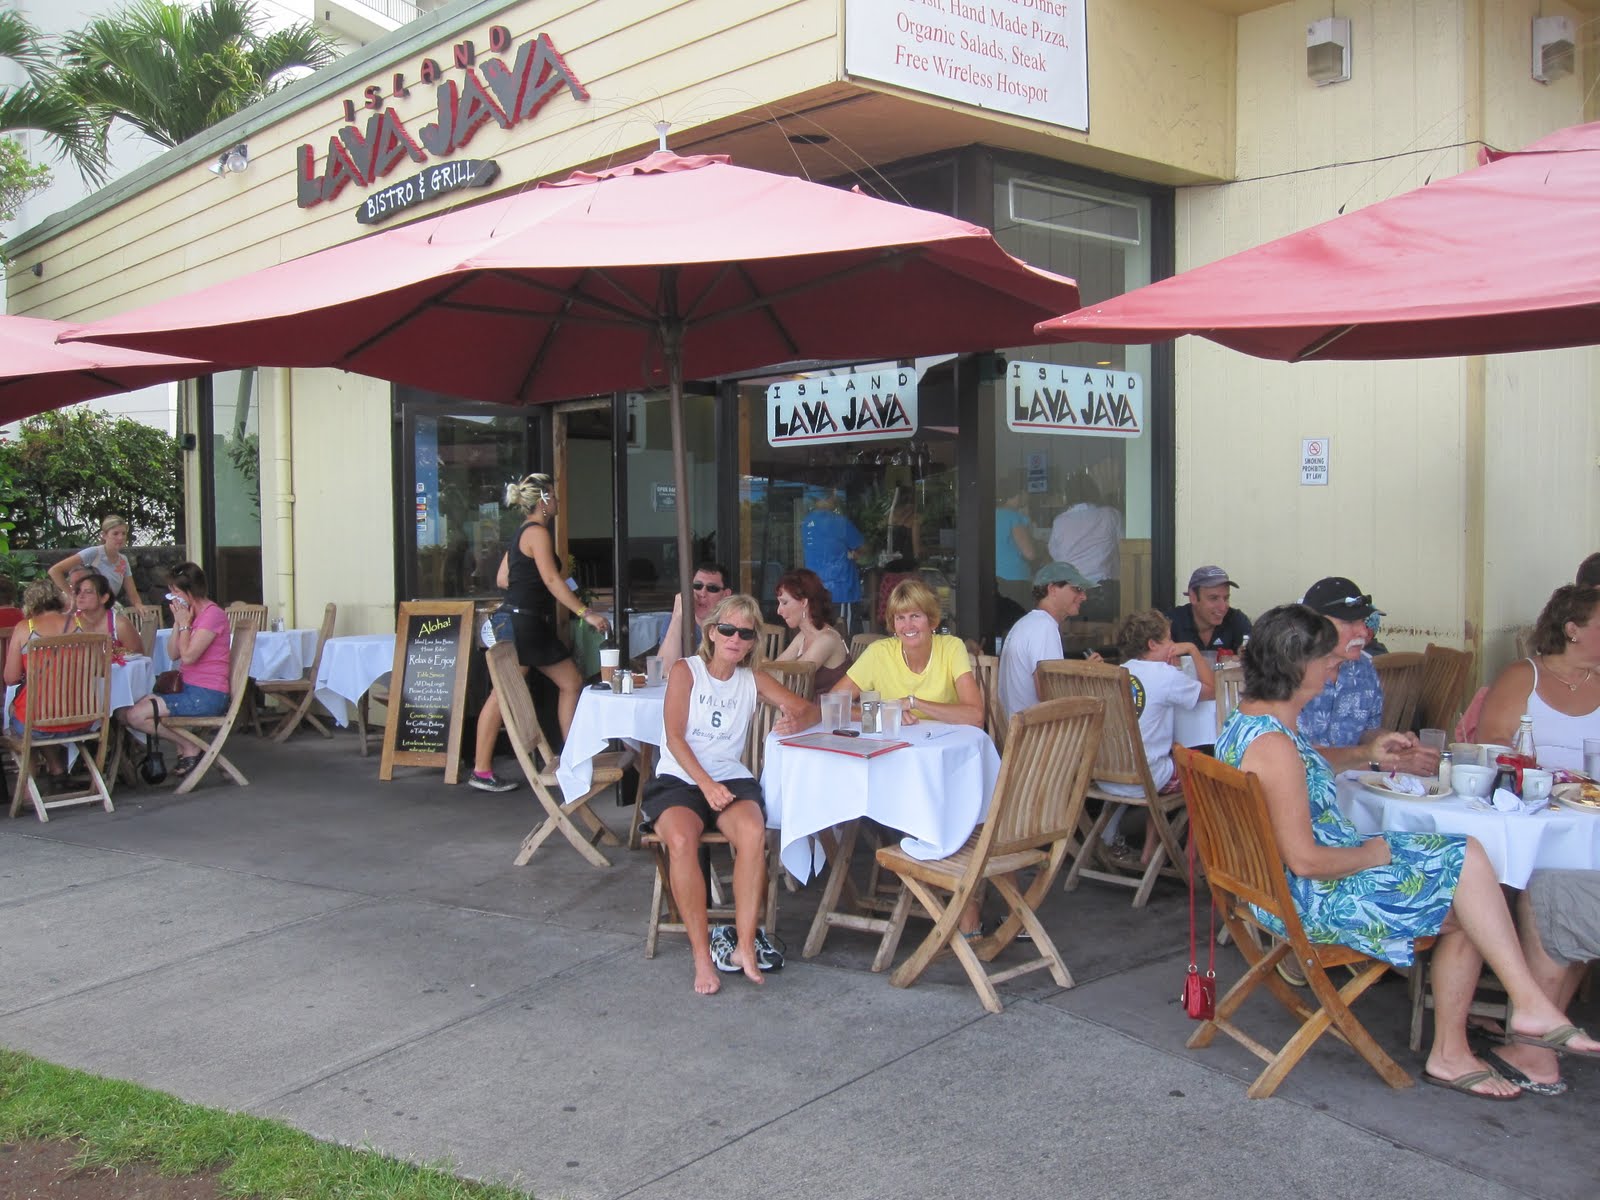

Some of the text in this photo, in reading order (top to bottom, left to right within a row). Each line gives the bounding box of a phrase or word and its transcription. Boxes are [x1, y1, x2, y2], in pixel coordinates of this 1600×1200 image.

[896, 12, 1047, 72] Organic Salads, Steak
[950, 0, 986, 24] Hand
[990, 9, 1028, 36] Made
[1032, 20, 1069, 50] Pizza,
[343, 25, 512, 122] ISLAND
[895, 45, 1048, 103] Free Wireless Hotspot
[297, 33, 590, 209] LAVA JAVA
[367, 161, 476, 219] BISTRO & GRILL
[773, 373, 908, 399] ISLAND
[1013, 365, 1136, 389] ISLAND
[774, 393, 911, 437] LAVA JAVA
[1014, 386, 1138, 427] LAVA JAVA
[418, 617, 451, 638] Aloha!
[409, 654, 427, 665] Relax
[433, 654, 456, 669] Enjoy!
[700, 694, 737, 709] VALLEY
[711, 711, 722, 728] 6
